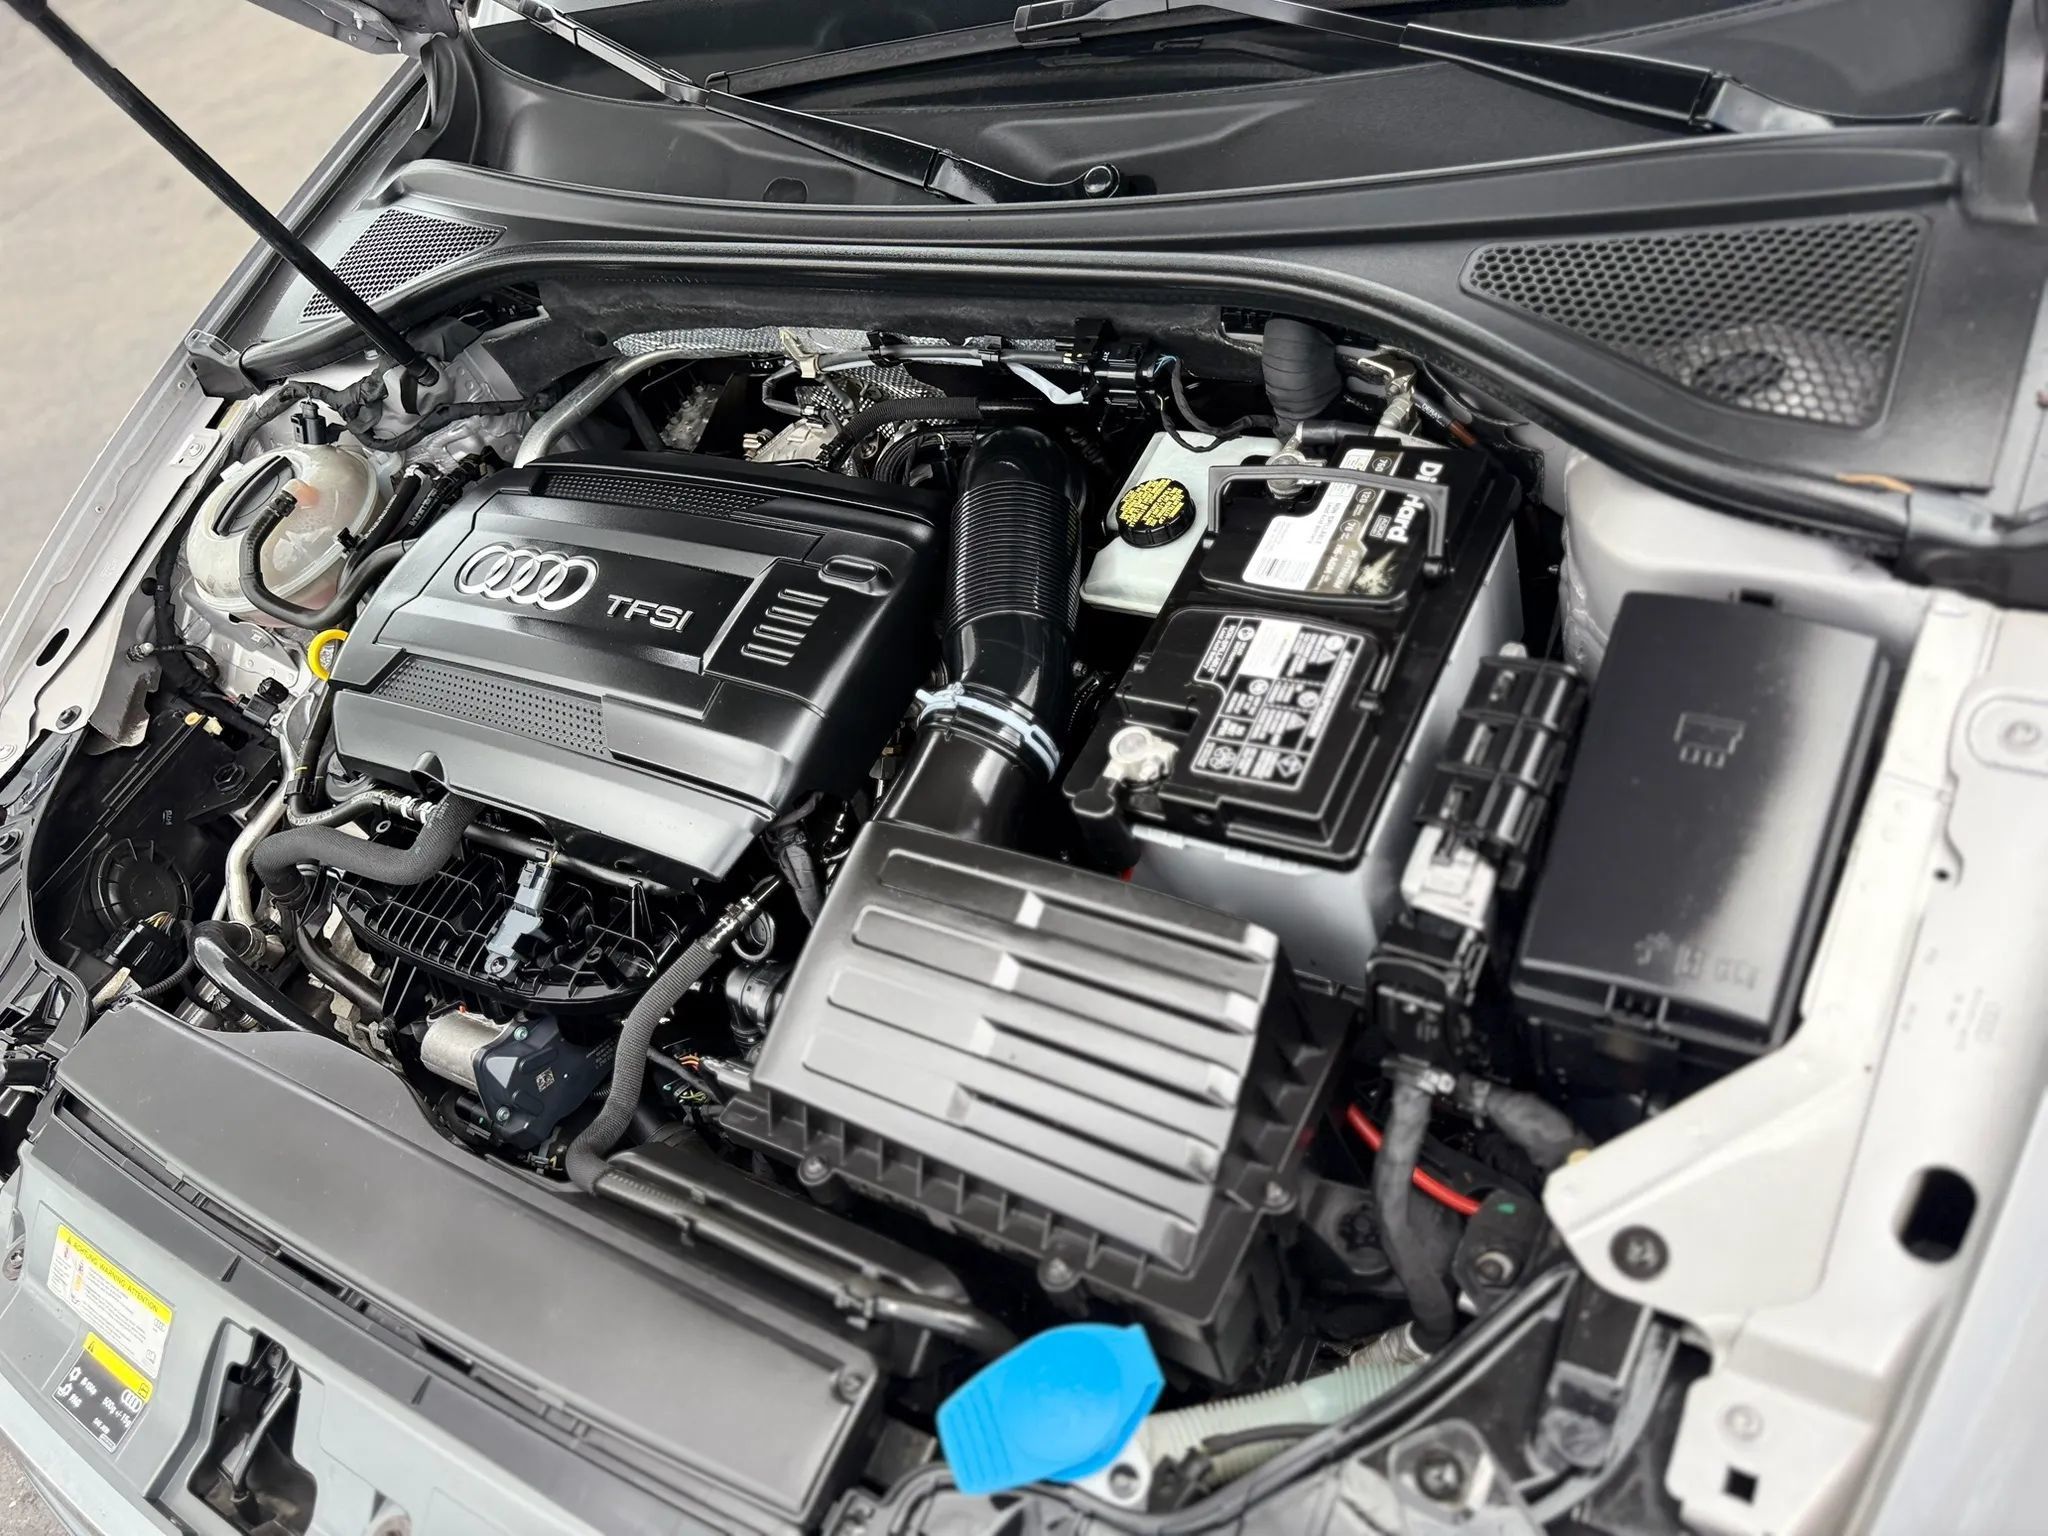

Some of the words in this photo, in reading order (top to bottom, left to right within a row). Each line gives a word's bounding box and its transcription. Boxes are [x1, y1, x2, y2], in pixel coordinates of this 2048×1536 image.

[1374, 459, 1389, 472] 760
[1359, 490, 1373, 504] 120
[1386, 461, 1444, 543] DiHard
[1344, 521, 1357, 532] 70
[1333, 549, 1358, 588] PLATINUM
[607, 594, 694, 633] TFSI
